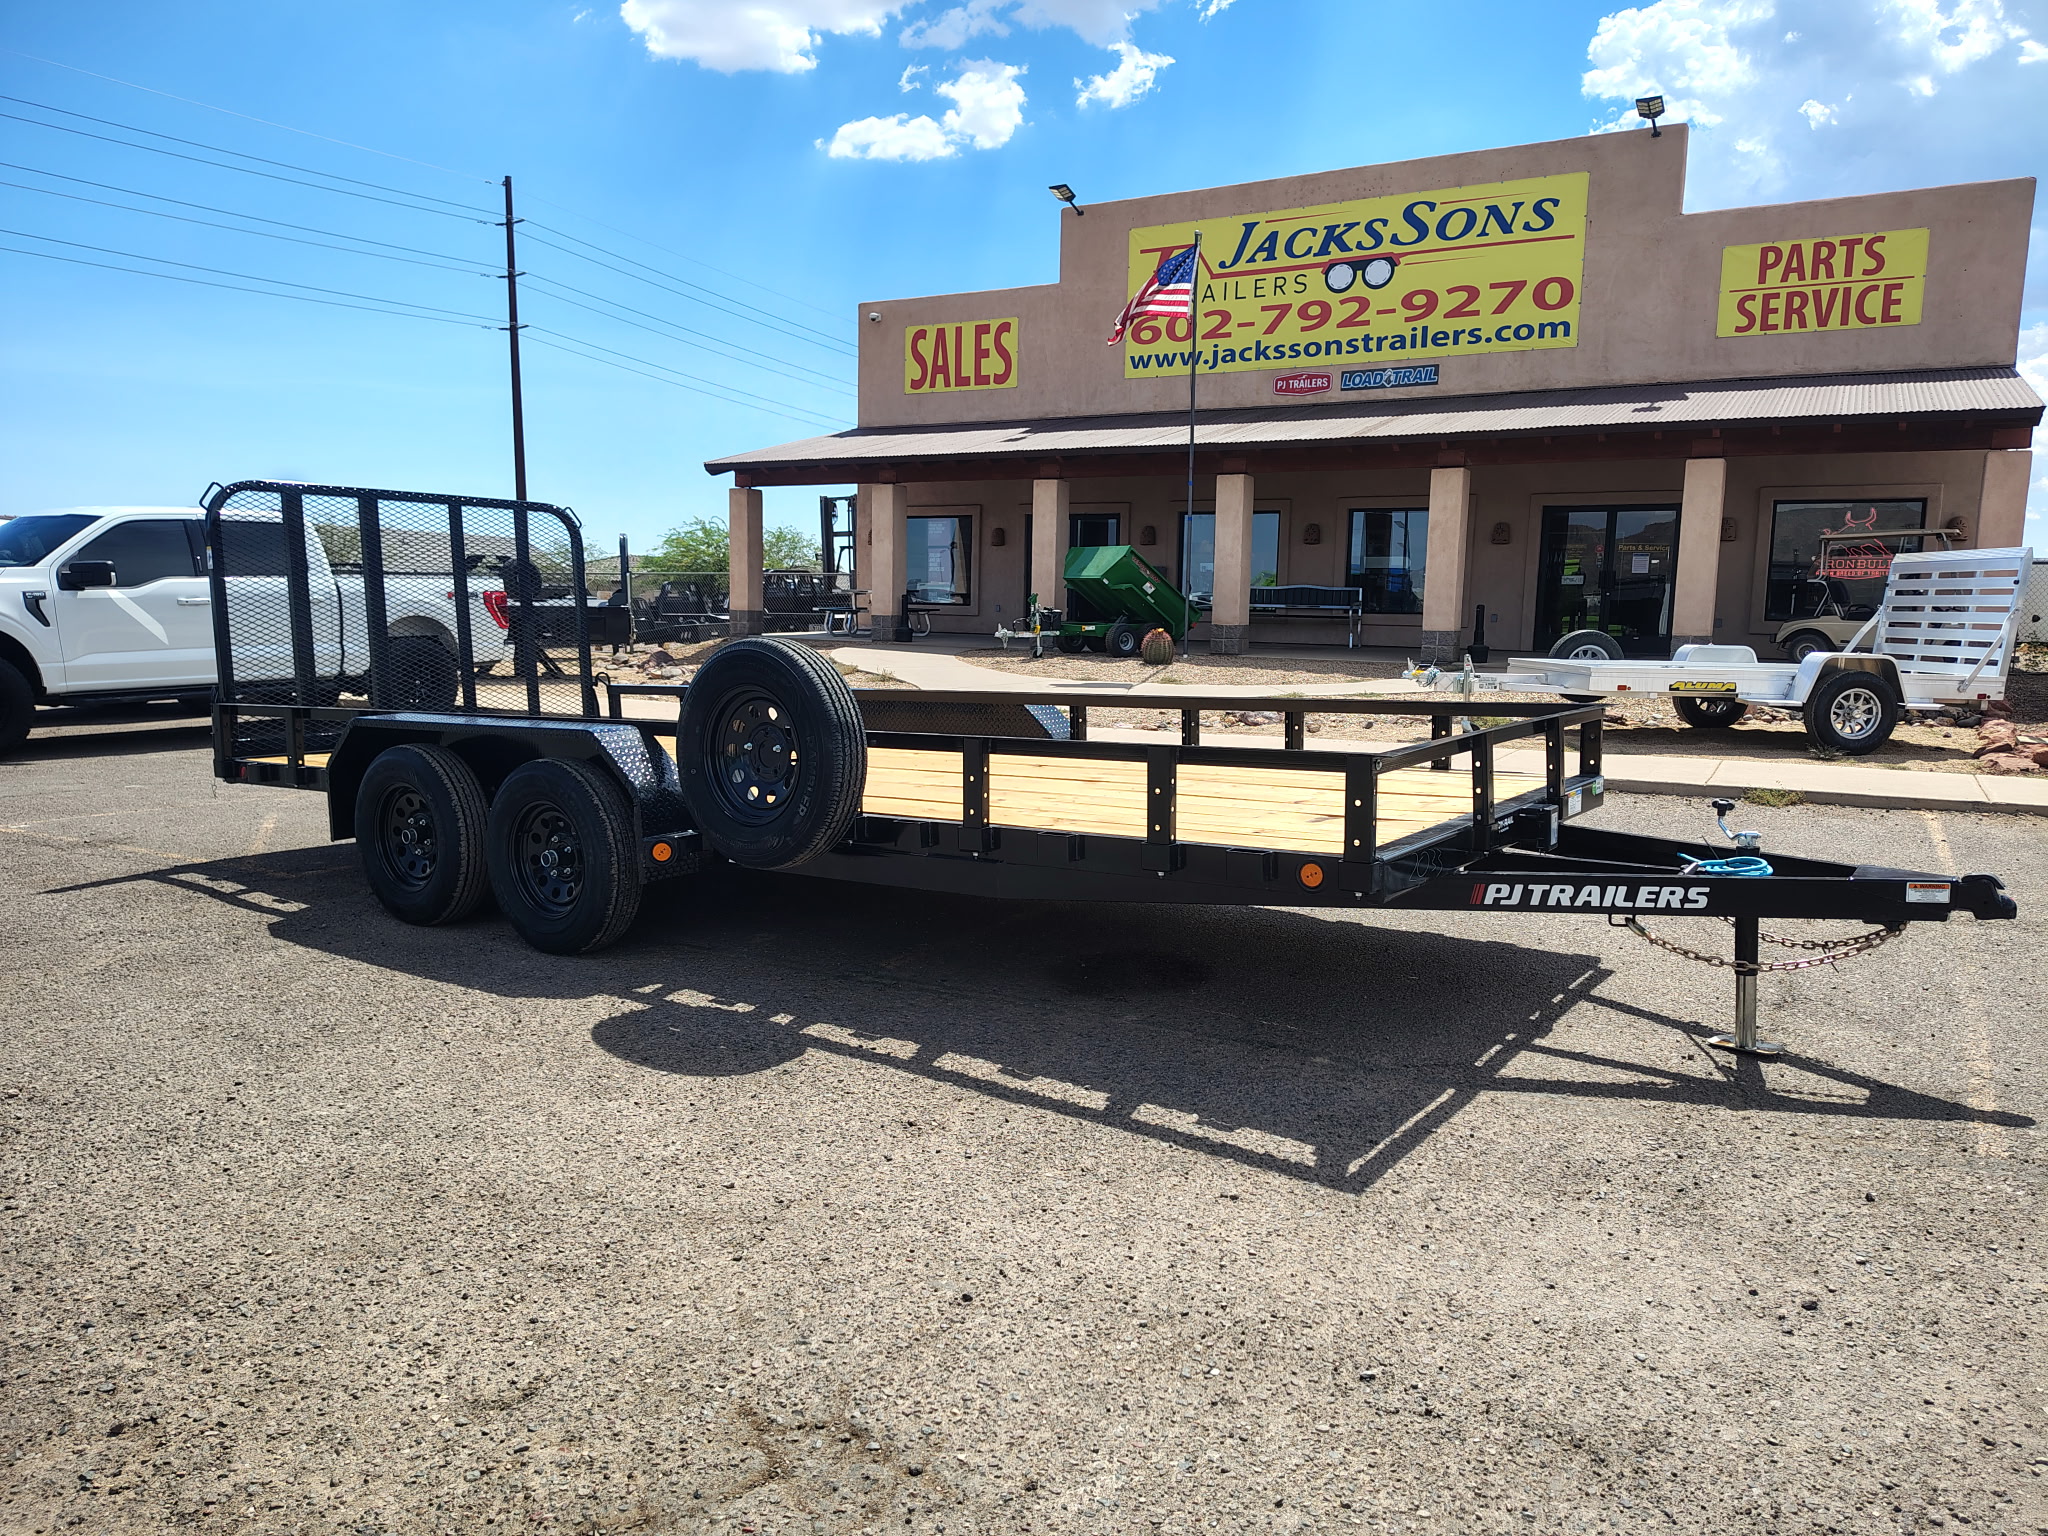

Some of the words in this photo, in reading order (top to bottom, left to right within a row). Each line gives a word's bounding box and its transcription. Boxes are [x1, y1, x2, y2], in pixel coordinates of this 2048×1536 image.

[1757, 235, 1886, 285] PARTS
[1131, 276, 1574, 345] 602-792-9270
[1734, 282, 1904, 333] SERVICE
[910, 321, 1012, 390] SALES
[1130, 320, 1572, 370] www.jackssonstrailers.com
[1276, 379, 1286, 390] PJ
[1288, 377, 1328, 389] TRAILERS
[1670, 681, 1736, 692] ALUMA
[1483, 883, 1524, 905] PJ
[1527, 884, 1711, 909] TRAILERS
